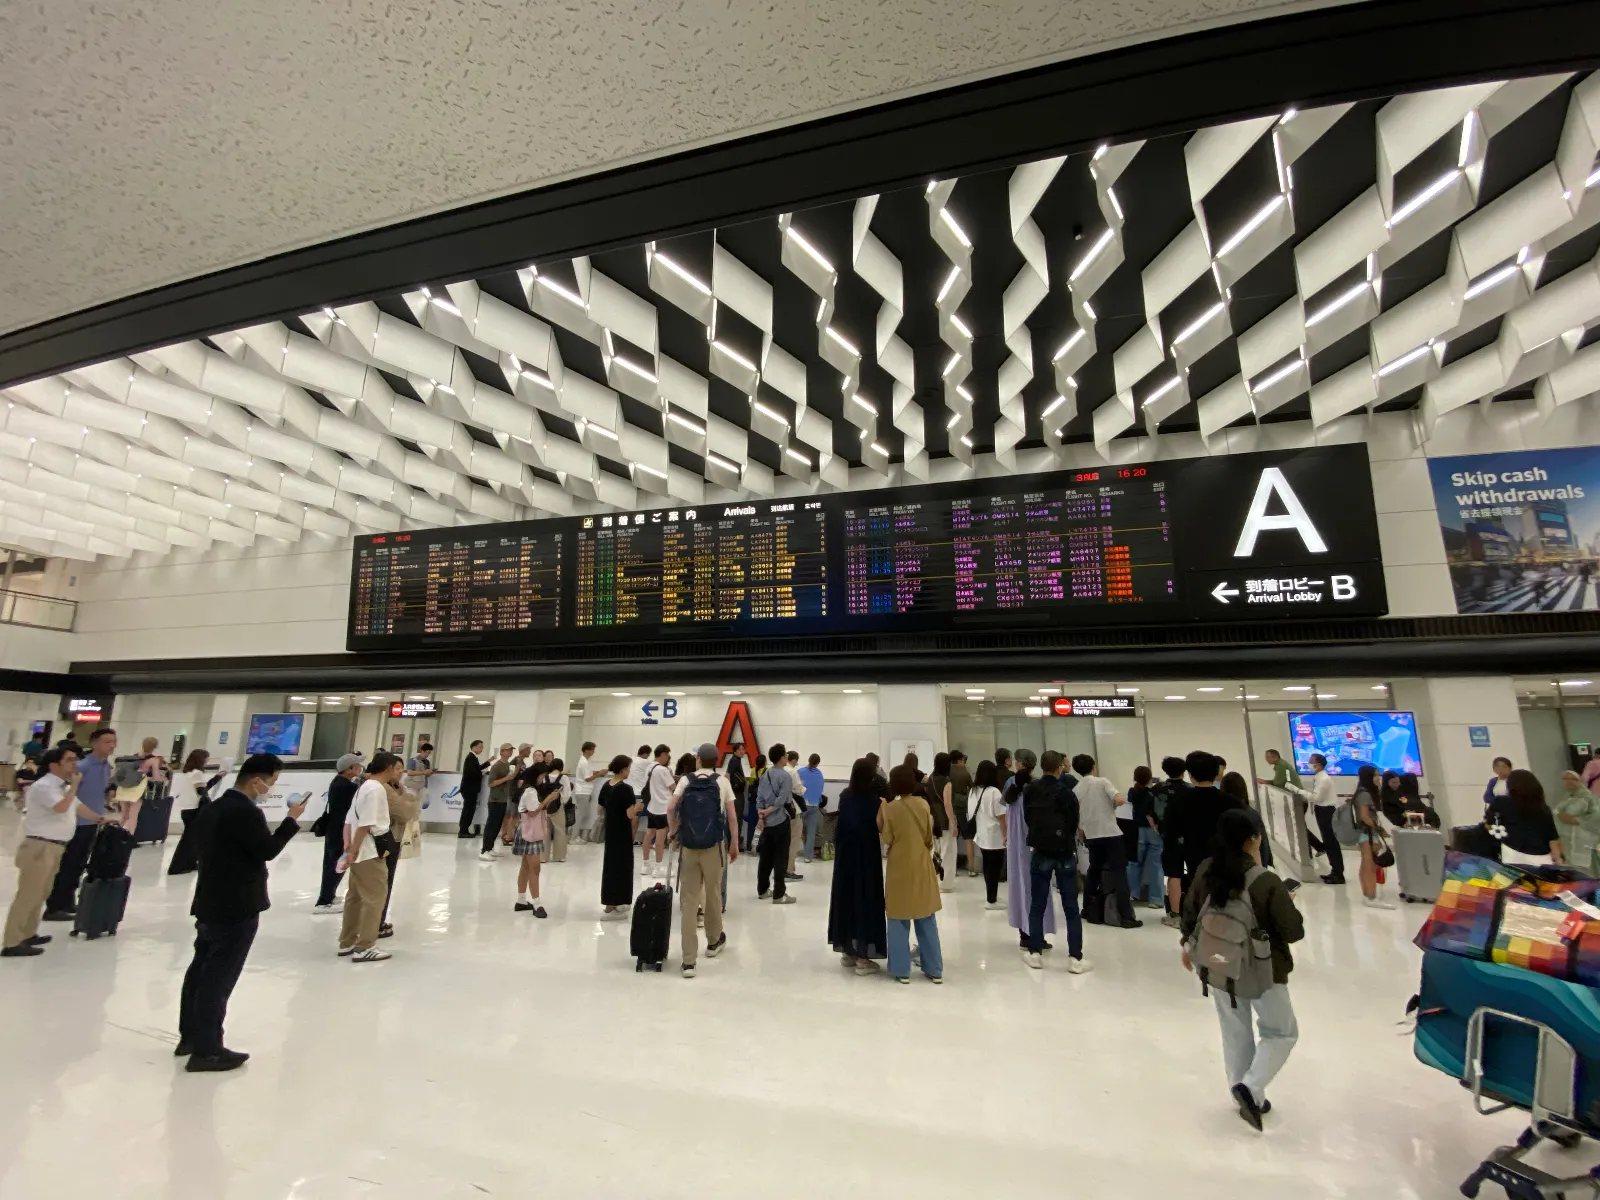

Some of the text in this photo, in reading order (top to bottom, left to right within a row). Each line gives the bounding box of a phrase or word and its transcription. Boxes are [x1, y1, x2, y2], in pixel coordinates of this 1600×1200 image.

[1451, 467, 1548, 487] Skip cash
[1455, 485, 1585, 505] withdrawals
[723, 505, 757, 517] Arrivals
[1233, 467, 1329, 557] A
[1245, 574, 1357, 600] 到着ロビー B
[1247, 591, 1322, 603] Arrival Lobby
[662, 698, 678, 719] B
[1083, 708, 1100, 716] Entry
[715, 700, 761, 769] A
